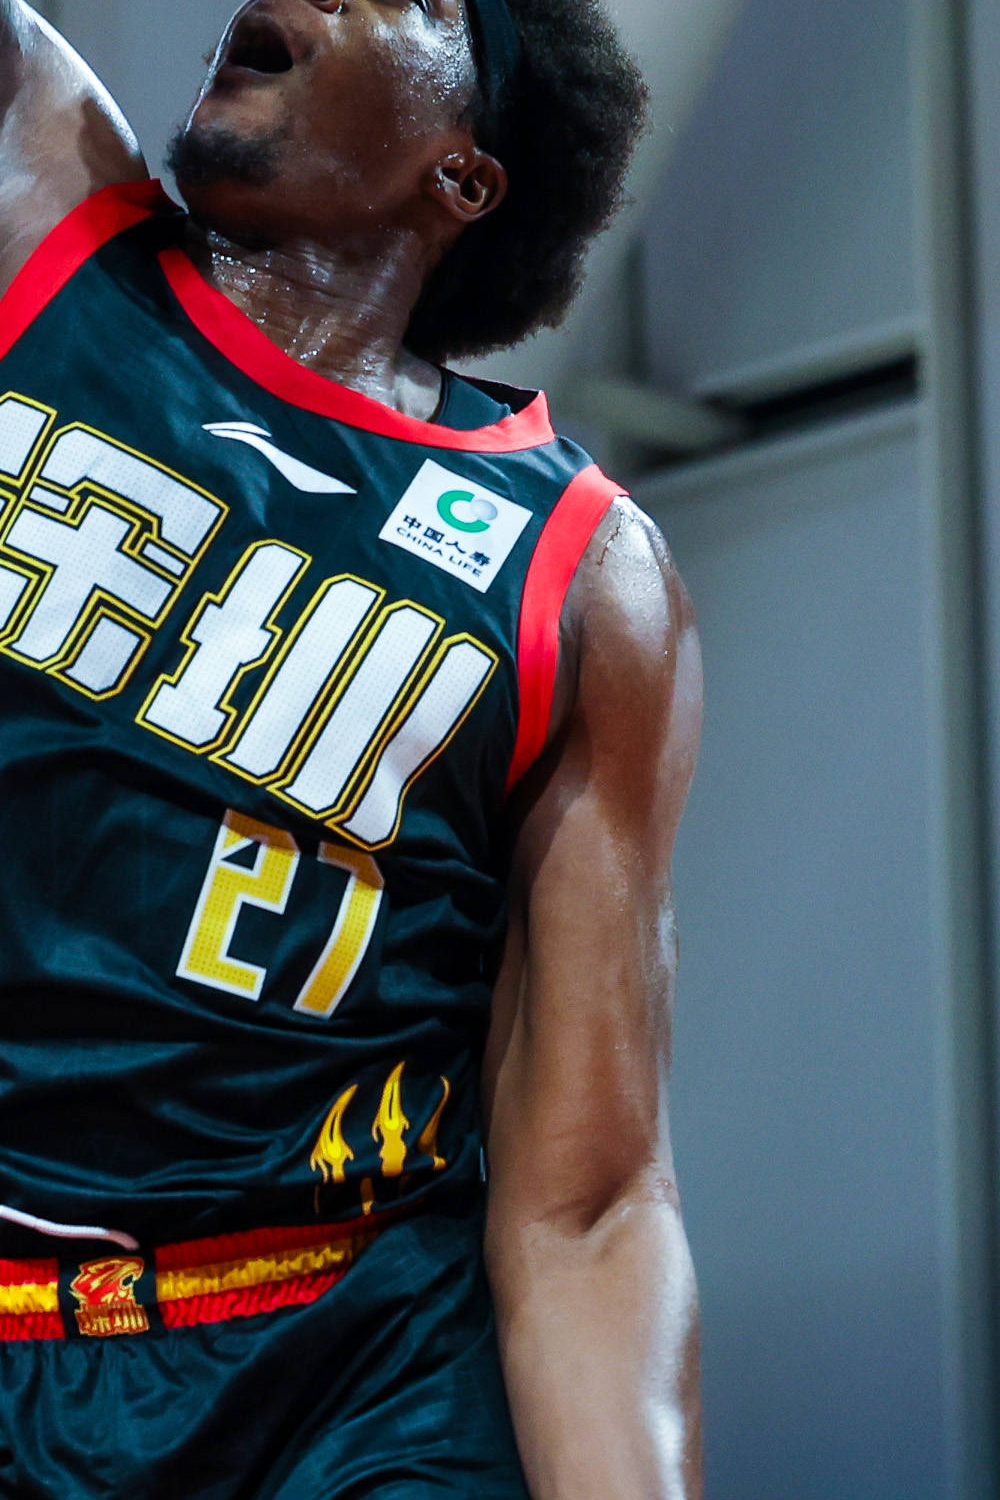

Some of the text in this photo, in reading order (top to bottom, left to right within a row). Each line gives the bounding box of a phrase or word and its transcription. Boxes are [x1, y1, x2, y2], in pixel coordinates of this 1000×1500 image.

[396, 527, 482, 578] CHINA LIFE
[403, 514, 491, 567] 中国人寿
[175, 808, 385, 1019] 27
